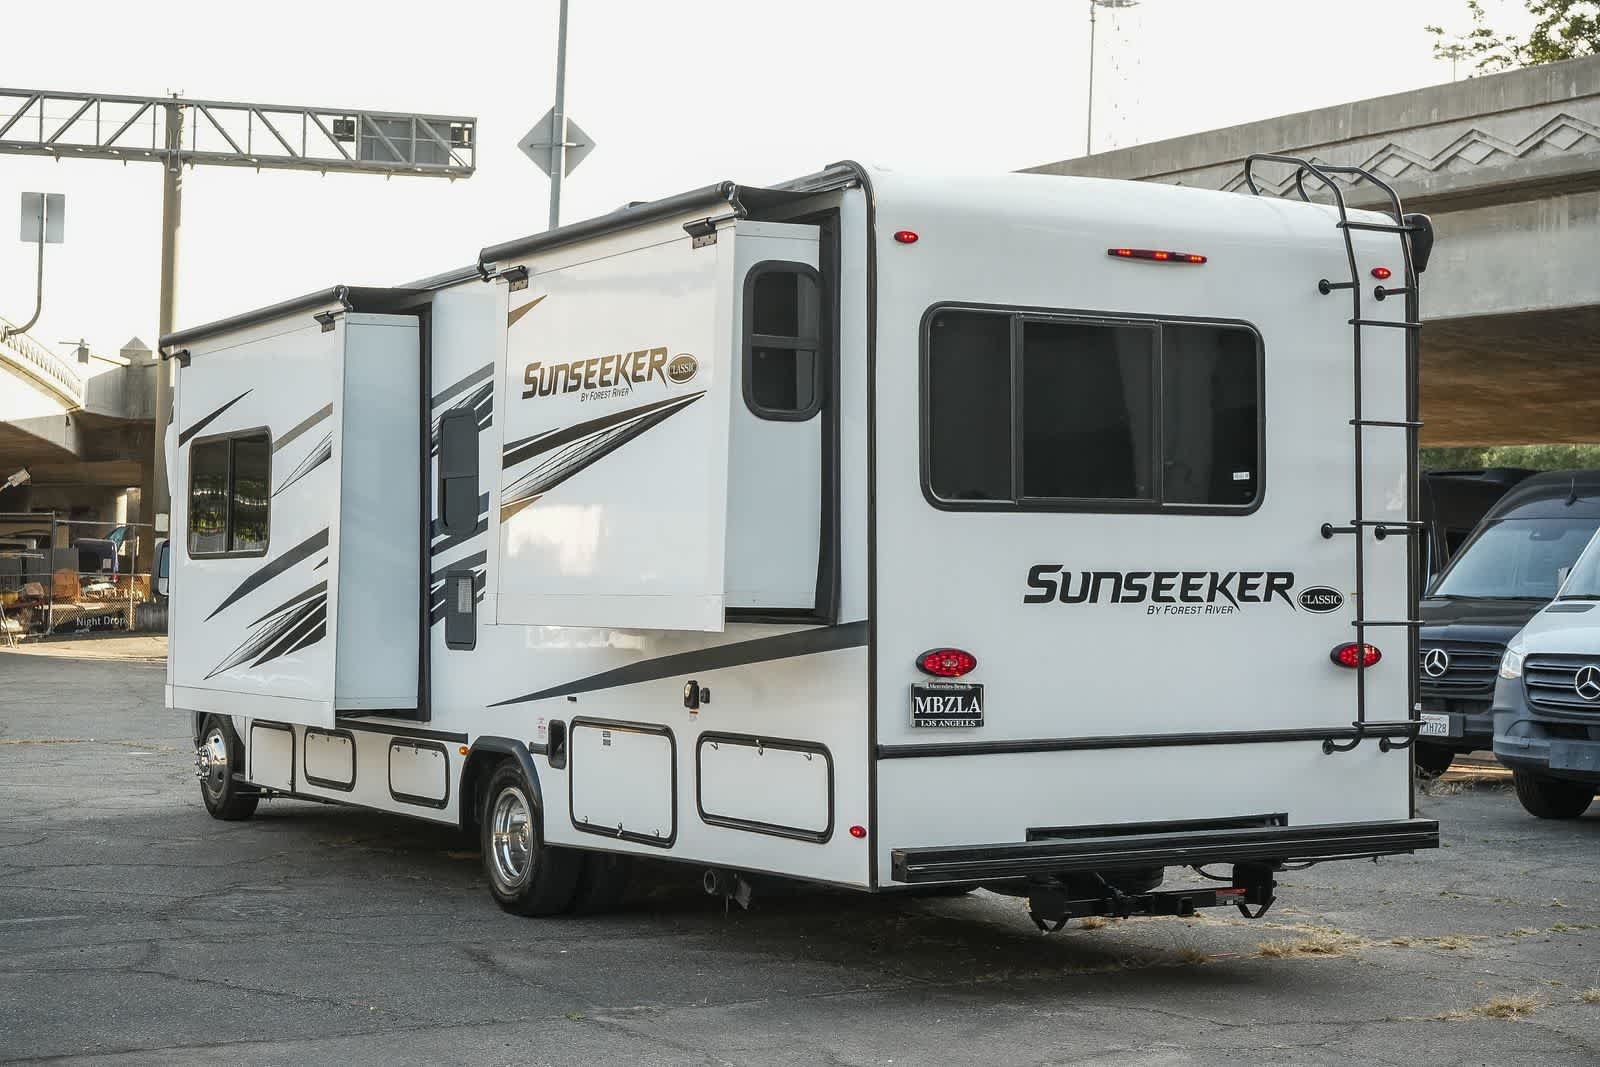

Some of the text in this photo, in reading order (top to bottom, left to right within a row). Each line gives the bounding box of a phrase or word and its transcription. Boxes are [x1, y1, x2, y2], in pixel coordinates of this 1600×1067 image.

[522, 346, 667, 400] SUNSEEKER
[590, 390, 611, 400] FOREST
[612, 388, 629, 398] RIVER
[1023, 564, 1297, 612] SUNSEEKER
[1300, 594, 1341, 605] CLASSIC
[1164, 605, 1202, 615] FOREST
[1205, 604, 1234, 615] RIVER
[76, 616, 101, 628] Night
[914, 696, 981, 714] MBZLA
